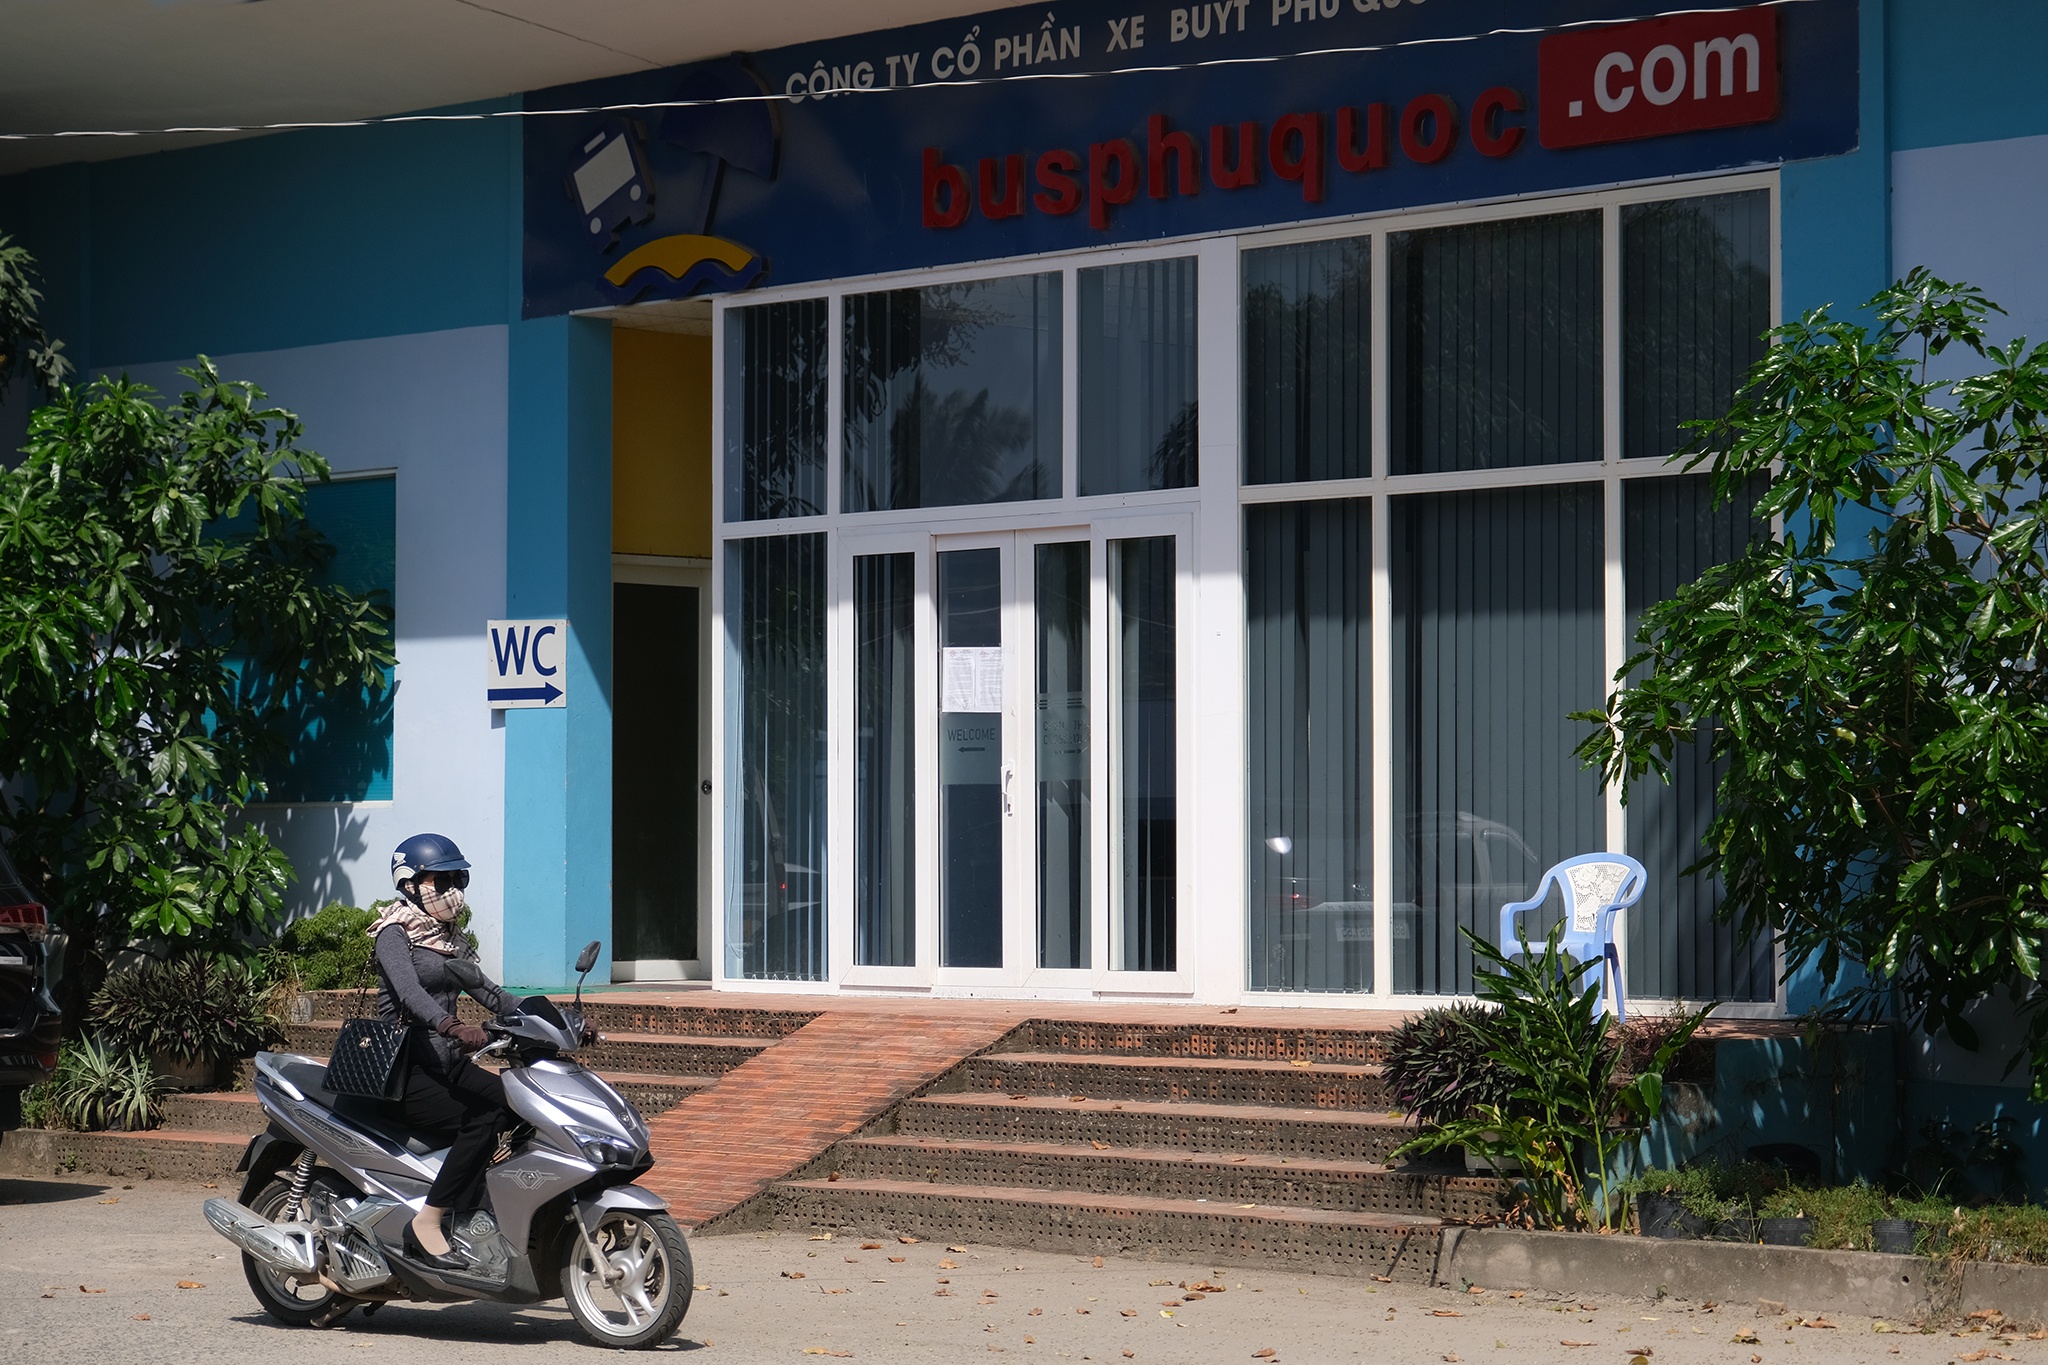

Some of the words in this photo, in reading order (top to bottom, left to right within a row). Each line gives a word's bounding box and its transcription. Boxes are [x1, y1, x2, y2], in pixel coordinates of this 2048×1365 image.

[786, 60, 874, 104] CÔNG
[886, 52, 920, 87] TY
[931, 25, 982, 80] CỔ
[994, 11, 1081, 71] PHẦN
[1106, 15, 1145, 53] XE
[921, 86, 1528, 230] busphuquoc
[1568, 32, 1761, 118] .com
[490, 625, 558, 677] WC
[947, 728, 996, 742] WELCOME
